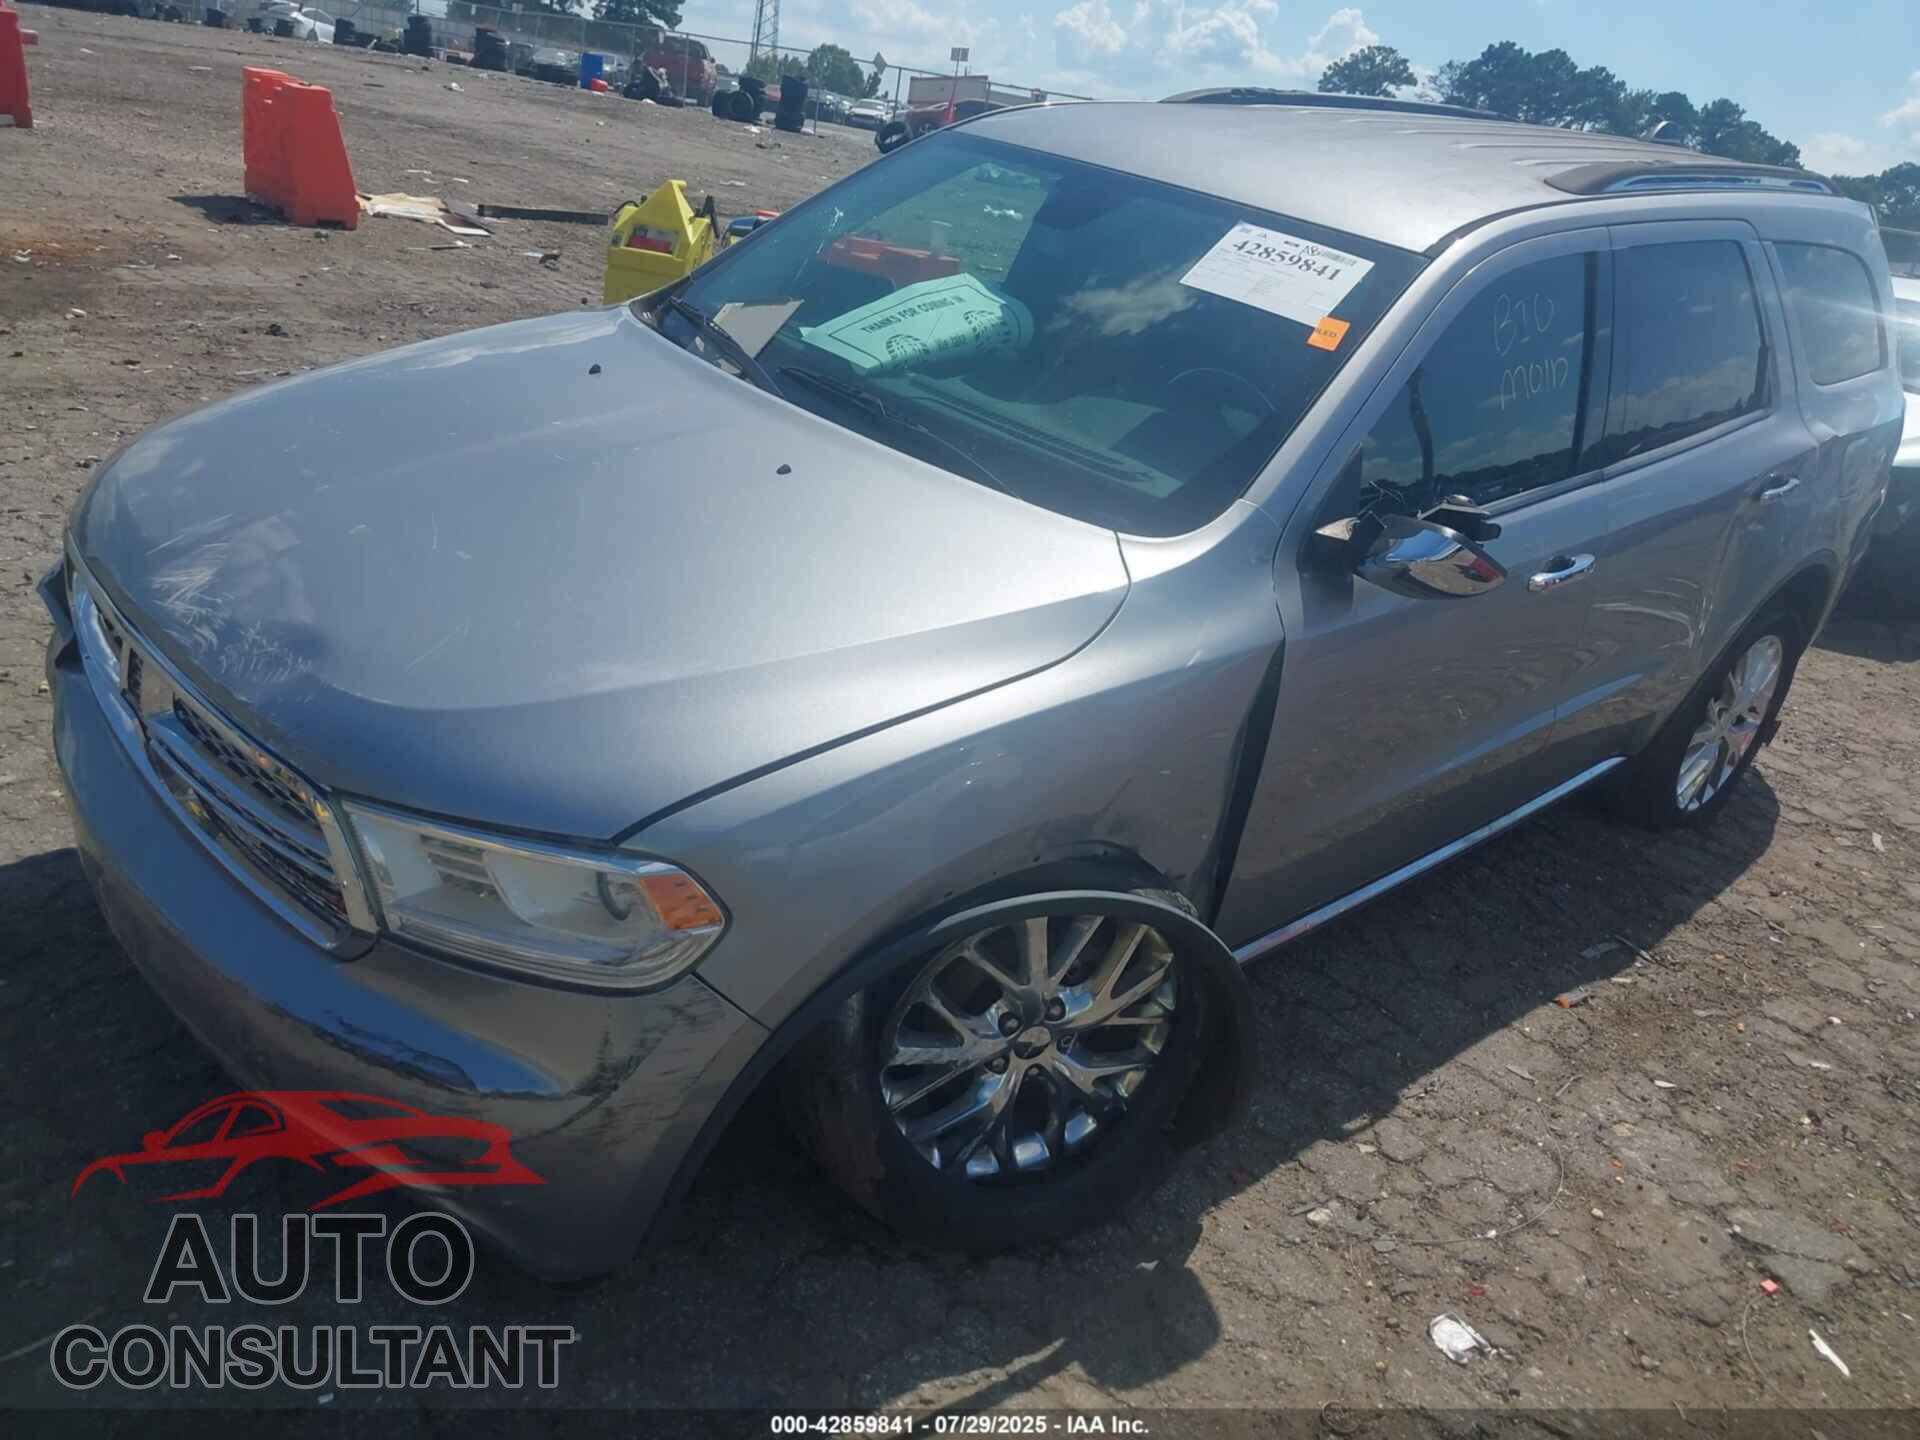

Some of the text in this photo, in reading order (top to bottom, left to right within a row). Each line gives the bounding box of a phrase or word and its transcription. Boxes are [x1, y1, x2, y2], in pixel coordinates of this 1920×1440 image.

[1232, 239, 1342, 281] 42859841
[861, 315, 902, 334] THANKS
[897, 307, 919, 320] FOR
